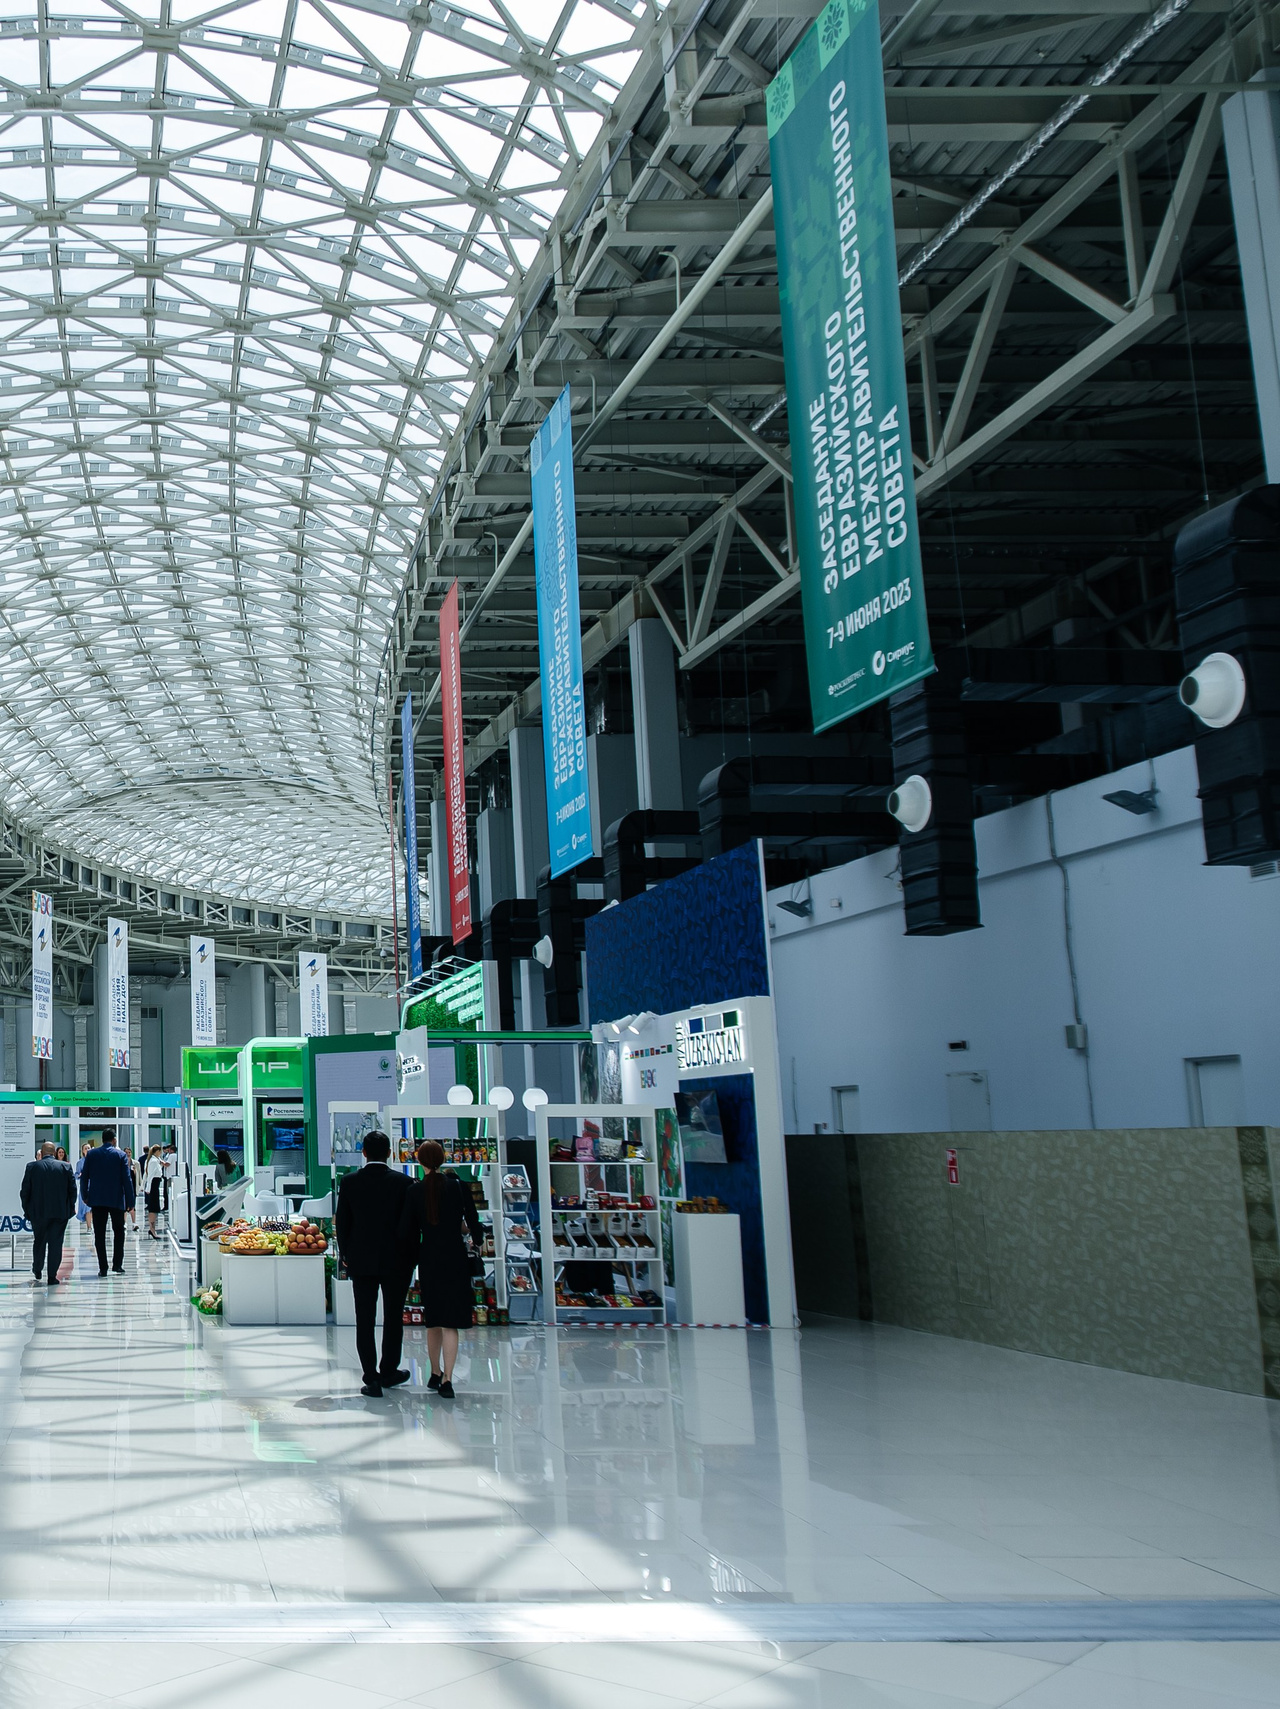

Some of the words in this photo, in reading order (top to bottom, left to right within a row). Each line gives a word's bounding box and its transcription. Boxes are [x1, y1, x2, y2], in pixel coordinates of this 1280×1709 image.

[829, 80, 883, 566] МЕЖПРАВИТЕЛЬСТВЕННОГО
[809, 391, 839, 595] ЗАСЕДАНИЕ
[824, 310, 861, 580] ЕВРАЗИЙСКОГО
[879, 404, 908, 549] СОВЕТА
[554, 460, 574, 778] МЕЖПРАВИТЕЛЬСТВЕННОГО
[826, 620, 845, 650] 7-9
[845, 595, 881, 638] ИЮНЯ
[882, 577, 912, 615] 2023
[886, 641, 915, 663] Сириус
[548, 657, 560, 790] ЗАСЕДАНИЕ
[553, 608, 568, 784] ЕВРАЗИЙСКОГО
[573, 681, 585, 772] СОВЕТА
[32, 1035, 53, 1059] ЕАЭС
[109, 1048, 130, 1067] ЕАЭС
[685, 1029, 742, 1067] UZBEKISTAN
